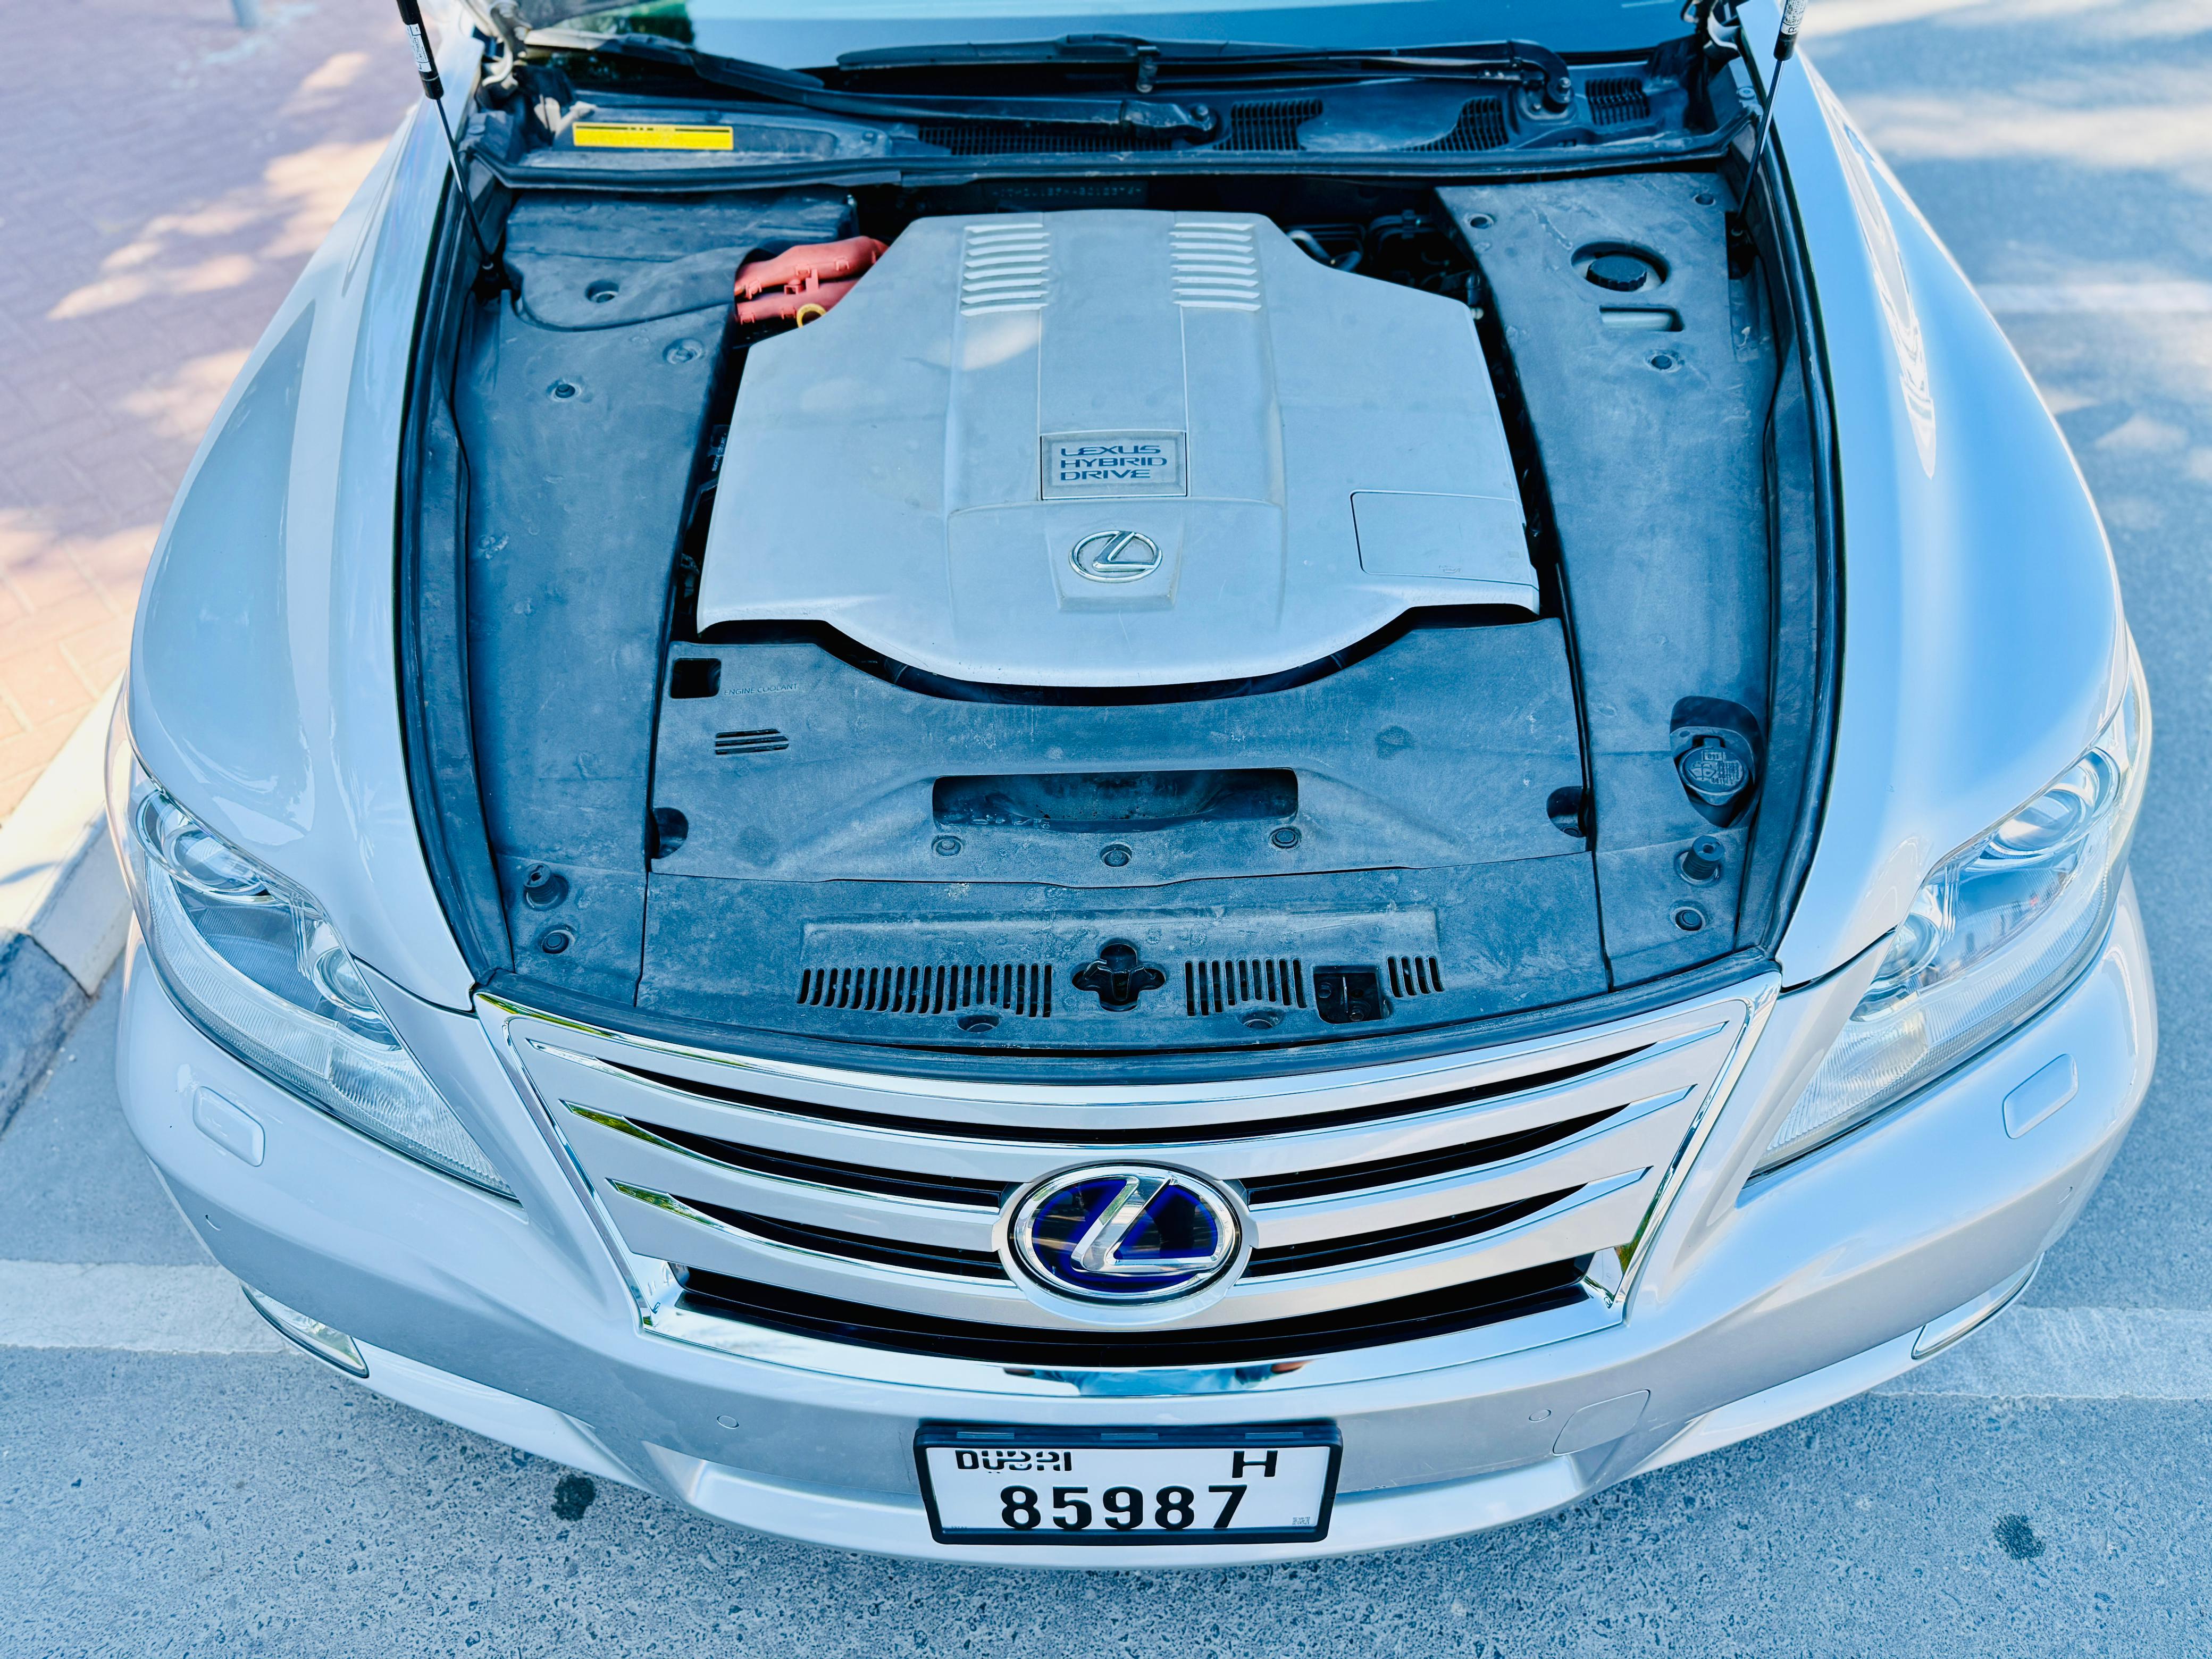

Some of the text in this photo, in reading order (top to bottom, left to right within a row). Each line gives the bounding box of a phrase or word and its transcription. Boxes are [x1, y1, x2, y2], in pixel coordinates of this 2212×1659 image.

[1060, 445, 1161, 456] LEXUS
[1060, 457, 1168, 468] HYBRID
[1060, 469, 1151, 481] DRIVE
[757, 683, 797, 693] COOLANT
[1231, 1450, 1278, 1478] H
[1000, 1484, 1248, 1530] 85987
